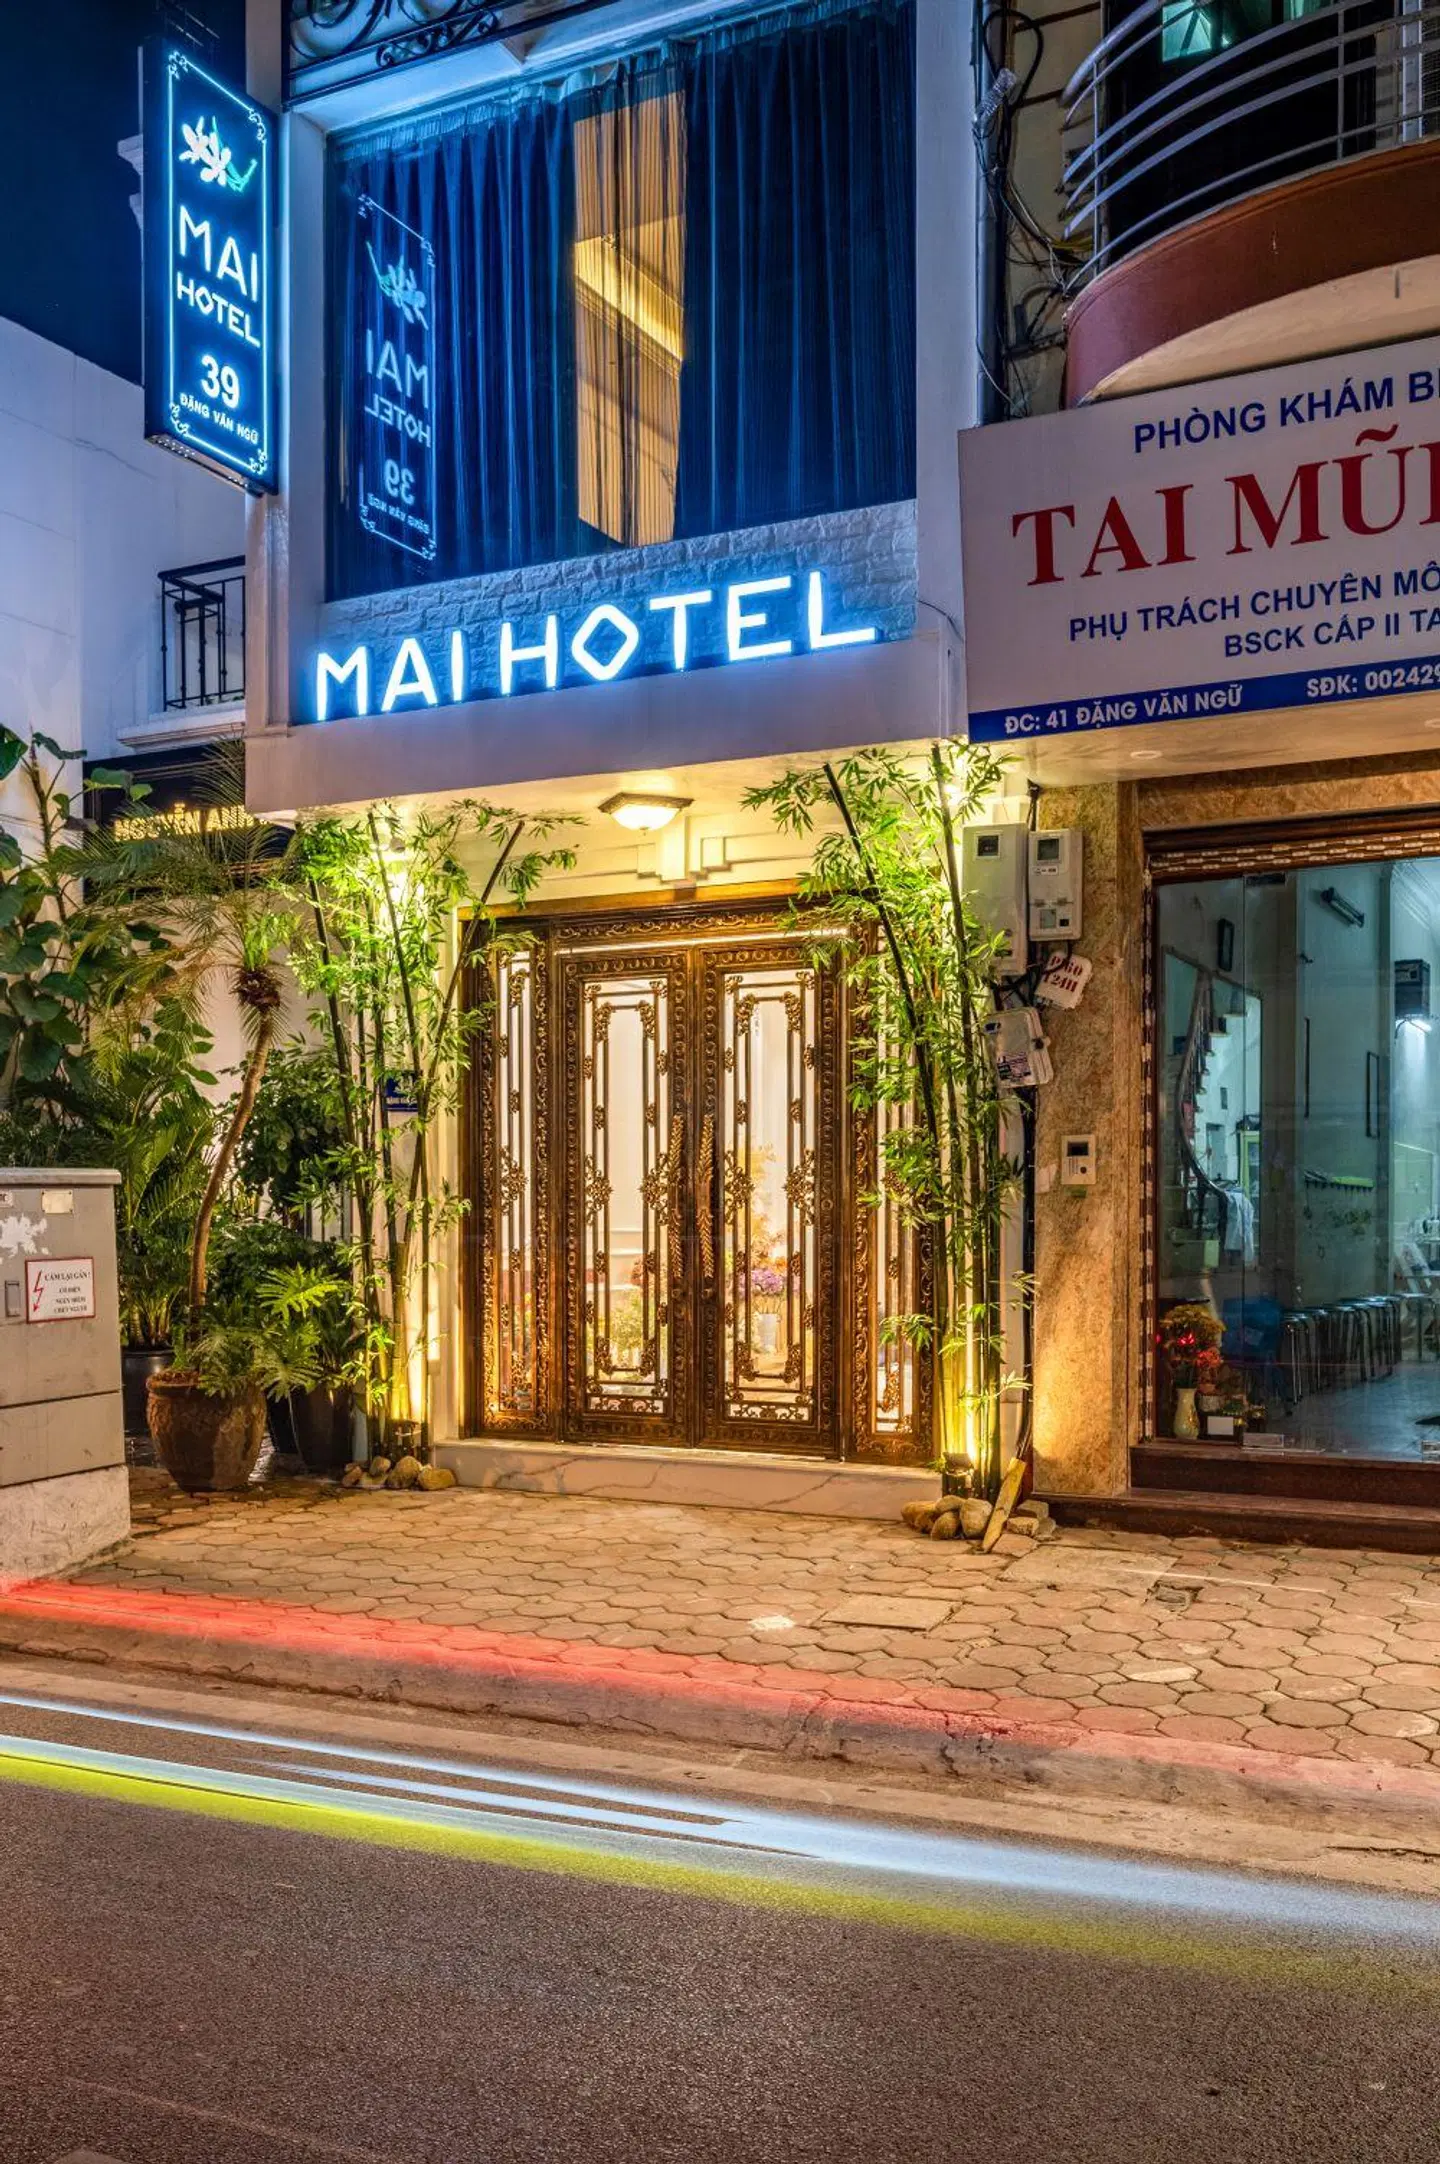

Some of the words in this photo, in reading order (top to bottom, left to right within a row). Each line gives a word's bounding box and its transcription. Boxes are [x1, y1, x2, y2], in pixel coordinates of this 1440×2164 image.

[179, 205, 258, 302] MAI
[177, 271, 261, 348] HOTEL
[201, 354, 240, 409] 39
[1135, 403, 1266, 453] PHÒNG
[1280, 377, 1394, 427] KHÁM
[1409, 368, 1440, 403] B
[1012, 484, 1197, 586] TAI
[1070, 611, 1128, 641] PHỤ
[1137, 595, 1240, 631] TRÁCH
[1250, 572, 1381, 616] CHUYÊN
[1225, 625, 1305, 657] BSCK
[1385, 612, 1399, 636] II
[316, 629, 464, 721] MAI
[501, 571, 877, 695] HOTEL
[1004, 712, 1041, 734] ĐC:
[1045, 709, 1067, 728] 41
[1076, 701, 1137, 729] ĐẶNG
[1143, 692, 1188, 717] VĂN
[1194, 684, 1243, 712] NGỮ
[1307, 674, 1358, 697] SĐK:
